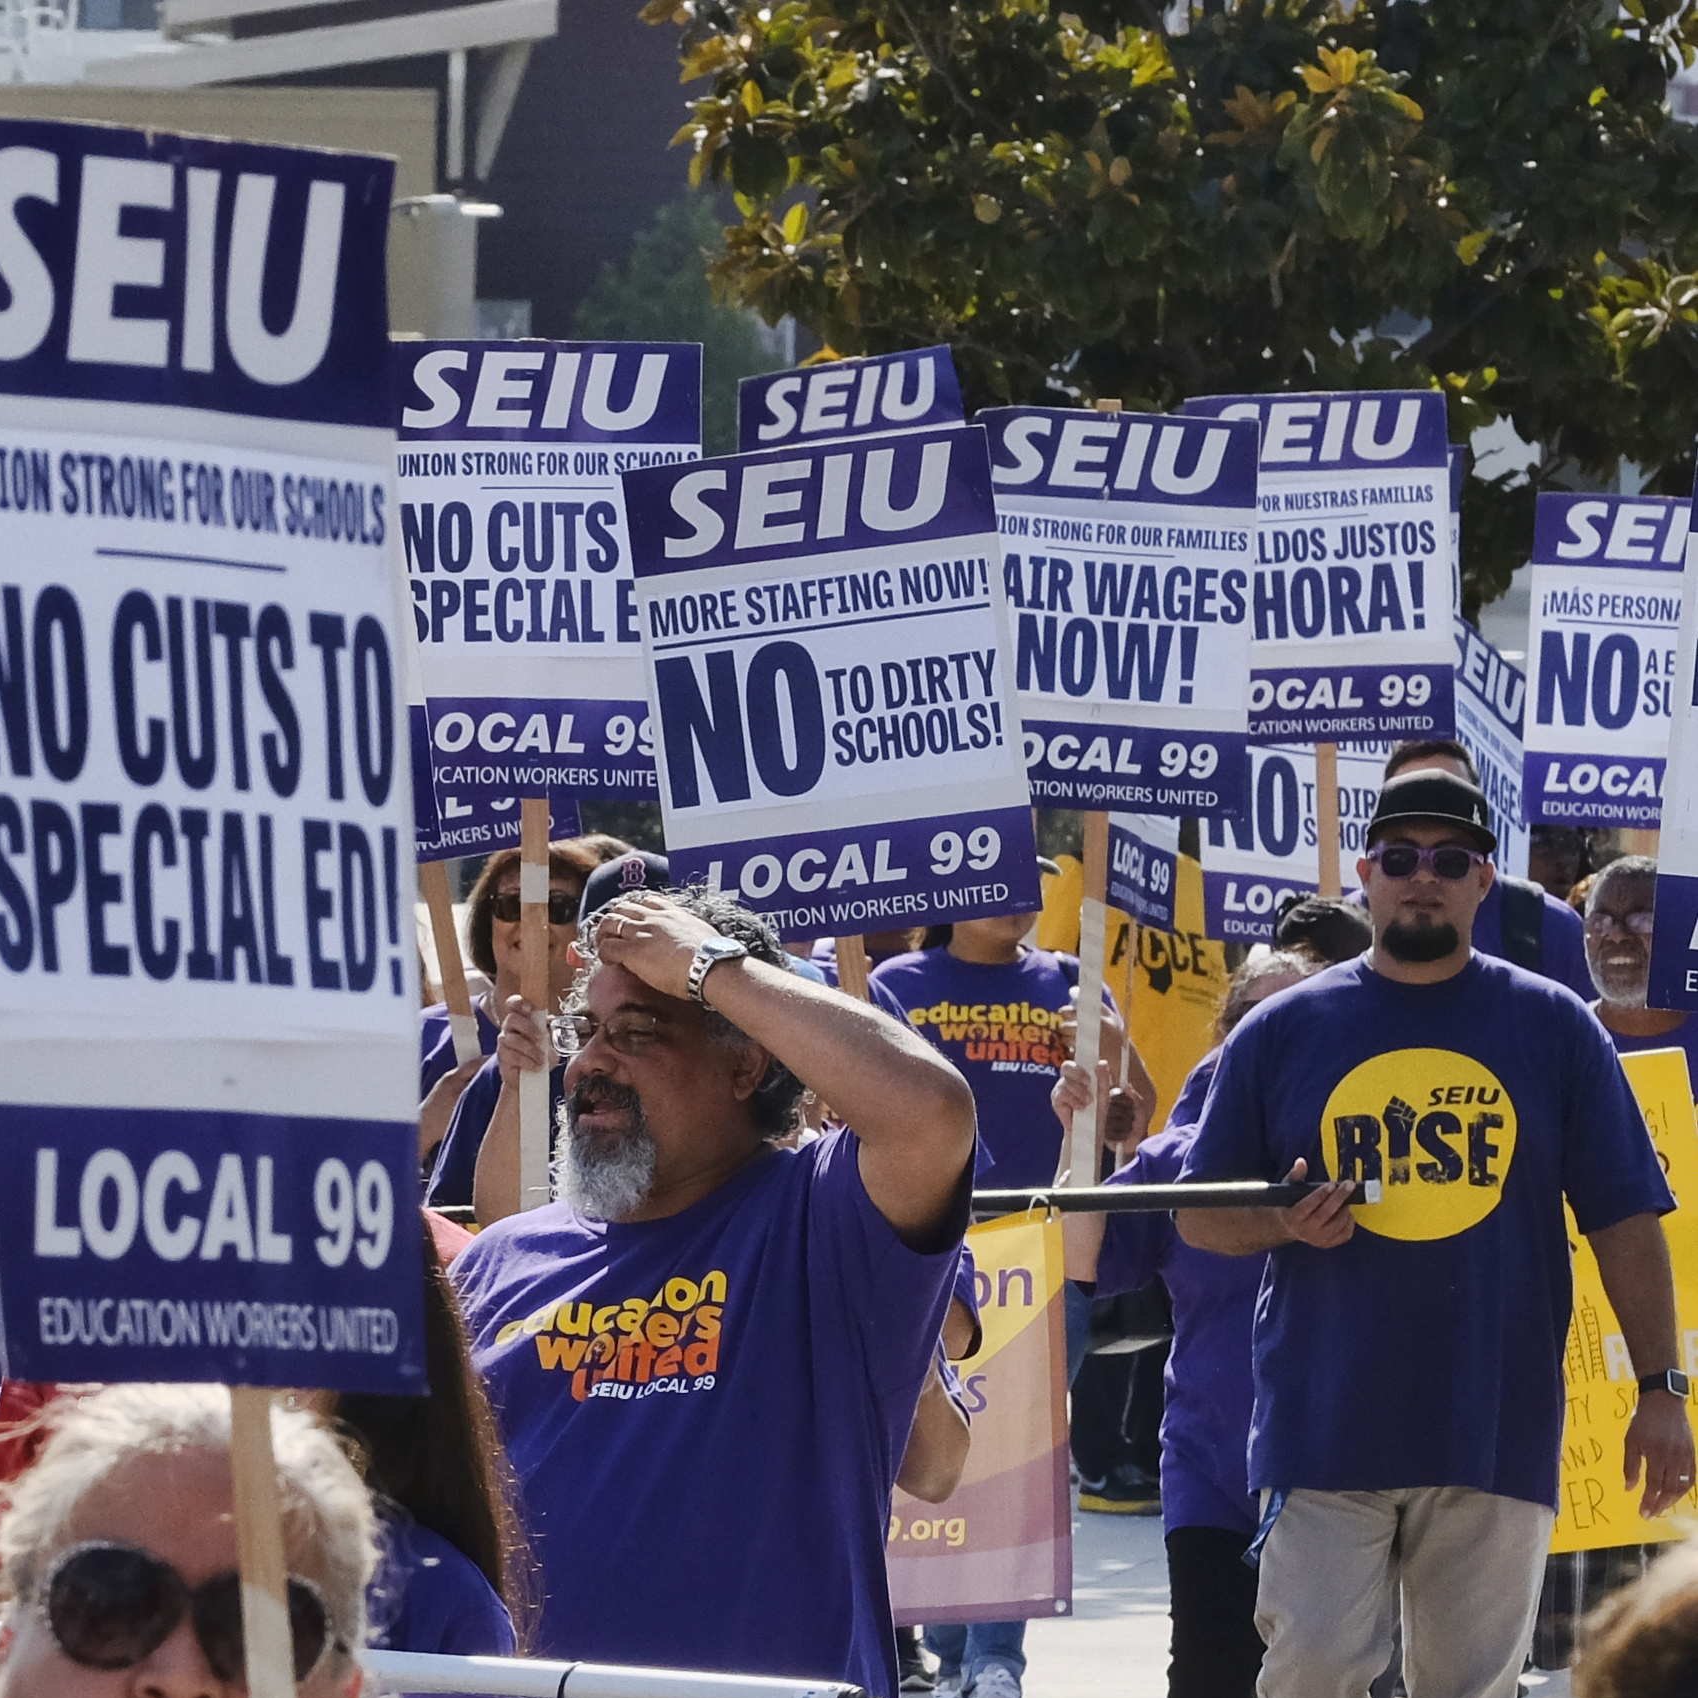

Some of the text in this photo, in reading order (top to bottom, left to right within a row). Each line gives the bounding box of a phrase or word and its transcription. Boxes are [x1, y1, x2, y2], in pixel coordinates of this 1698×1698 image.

[402, 350, 669, 431] SEIU
[758, 356, 935, 441] SEIU
[398, 452, 608, 477] UNION STRONG FOR OUR
[993, 416, 1231, 495] SEIU
[59, 452, 175, 522] STRONG
[180, 464, 226, 528] FOR
[231, 467, 279, 533] OUR
[281, 472, 385, 546] SCHOOLS
[664, 441, 952, 558] SEIU
[1285, 485, 1433, 513] NUESTRAS FAMILIAS
[401, 500, 620, 573] NO CUTS
[1032, 518, 1248, 552] STRONG FOR OUR FAMILIES
[1334, 520, 1436, 559] JUSTOS
[410, 578, 605, 643] SPECIAL
[649, 558, 990, 638] MORE STAFFING NOW!
[1085, 561, 1247, 625] WAGES
[1542, 587, 1593, 617] ¡MÁS
[825, 649, 996, 716] TO DIRTY
[1016, 613, 1199, 705] NOW!
[1380, 675, 1431, 706] 99
[1454, 623, 1526, 725] SEIU
[1536, 630, 1640, 730] NO
[111, 589, 302, 799] CUTS
[309, 611, 393, 807] TO
[655, 640, 825, 810] NO
[1305, 715, 1433, 734] WORKERS UNITED
[604, 715, 655, 756] 99
[831, 701, 1004, 767] SCHOOLS!
[1159, 742, 1218, 779] 99
[514, 768, 598, 786] WORKERS
[1077, 782, 1218, 807] WORKERS UNITED
[1542, 801, 1627, 819] EDUCATION
[619, 858, 646, 888] B
[708, 826, 1002, 902] LOCAL 99
[1150, 859, 1170, 895] 99
[303, 819, 404, 996] ED!
[830, 883, 1008, 923] WORKERS UNITED
[1022, 1064, 1057, 1076] LOCAL
[1427, 1086, 1501, 1106] SEIU
[1334, 1096, 1503, 1187] RISE
[34, 1148, 394, 1270] LOCAL 99
[40, 1295, 398, 1354] EDUCATION WORKERS UNITED
[588, 1375, 716, 1400] SEIU LOCAL 99
